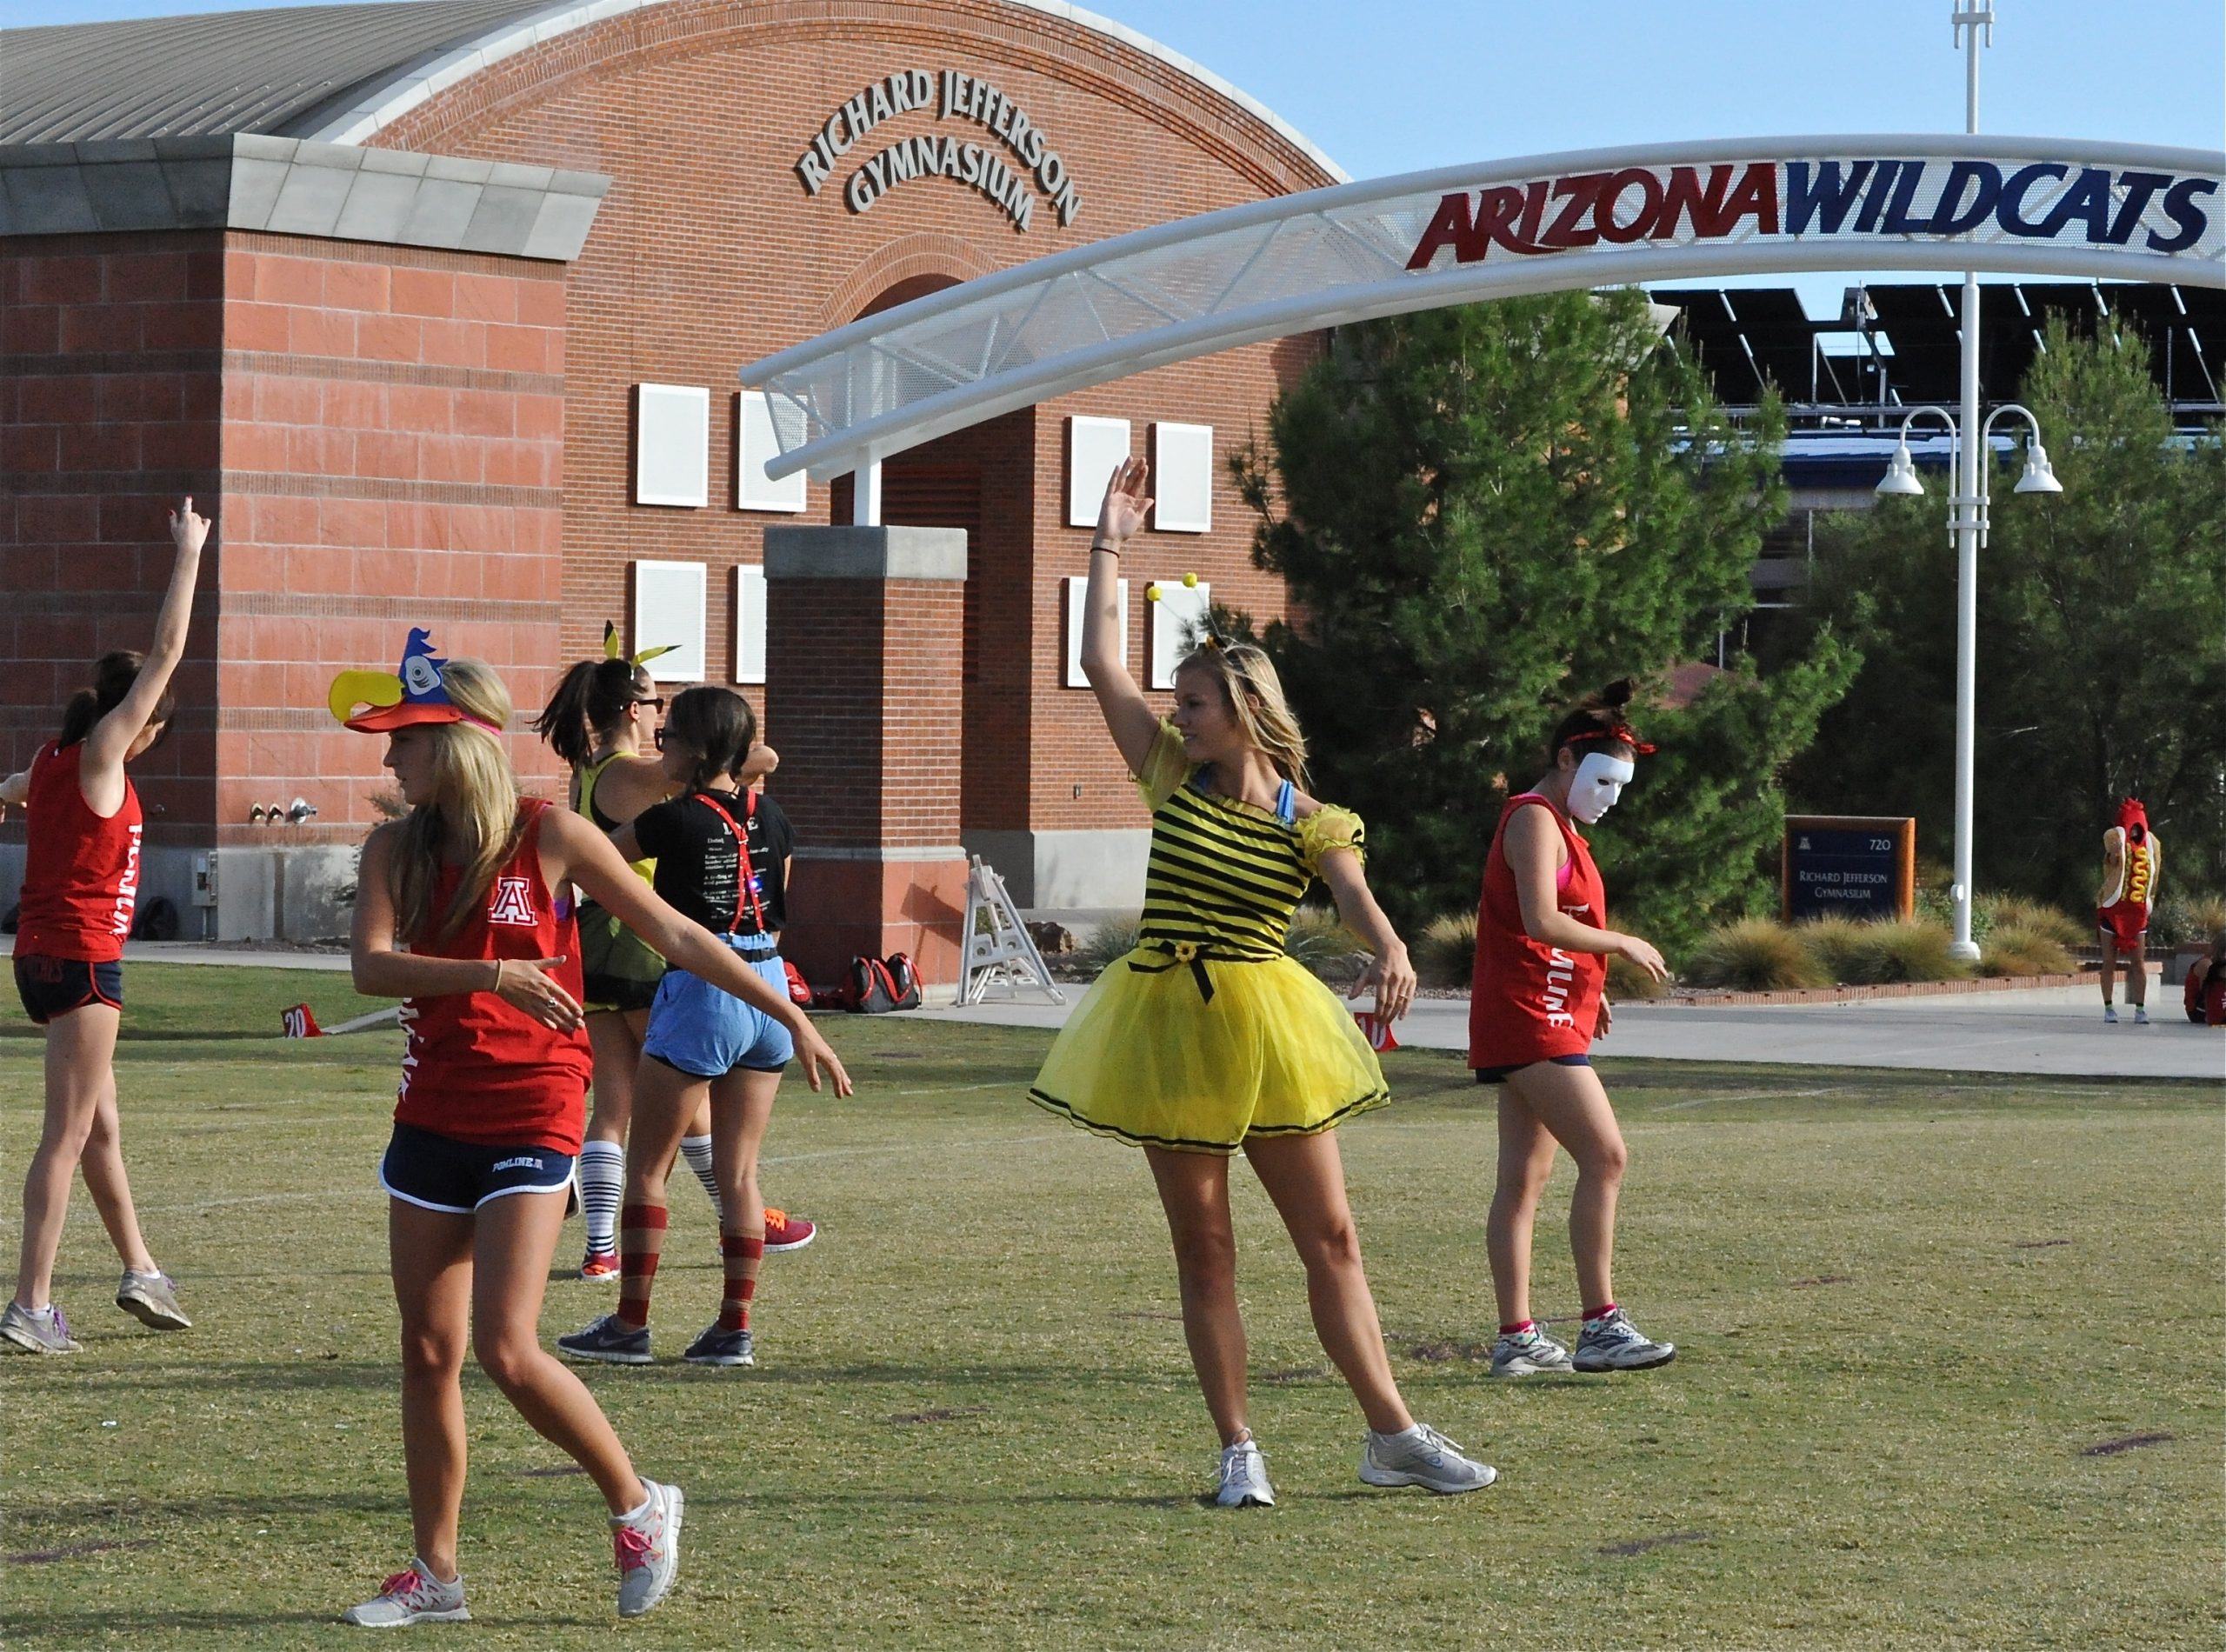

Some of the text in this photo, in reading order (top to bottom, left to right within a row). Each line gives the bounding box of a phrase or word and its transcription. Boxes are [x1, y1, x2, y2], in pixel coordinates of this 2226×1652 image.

[798, 70, 1083, 228] RICHARD JEFFERSON
[848, 135, 1036, 232] GYMNASIUM
[1405, 160, 2218, 270] ARIZONA WILDCATS
[1869, 839, 1890, 850] 720
[1799, 870, 1888, 885] RICHARD JEFFERSON
[1815, 887, 1871, 899] GYMNASIUM
[489, 876, 537, 926] A
[284, 1009, 306, 1038] 20
